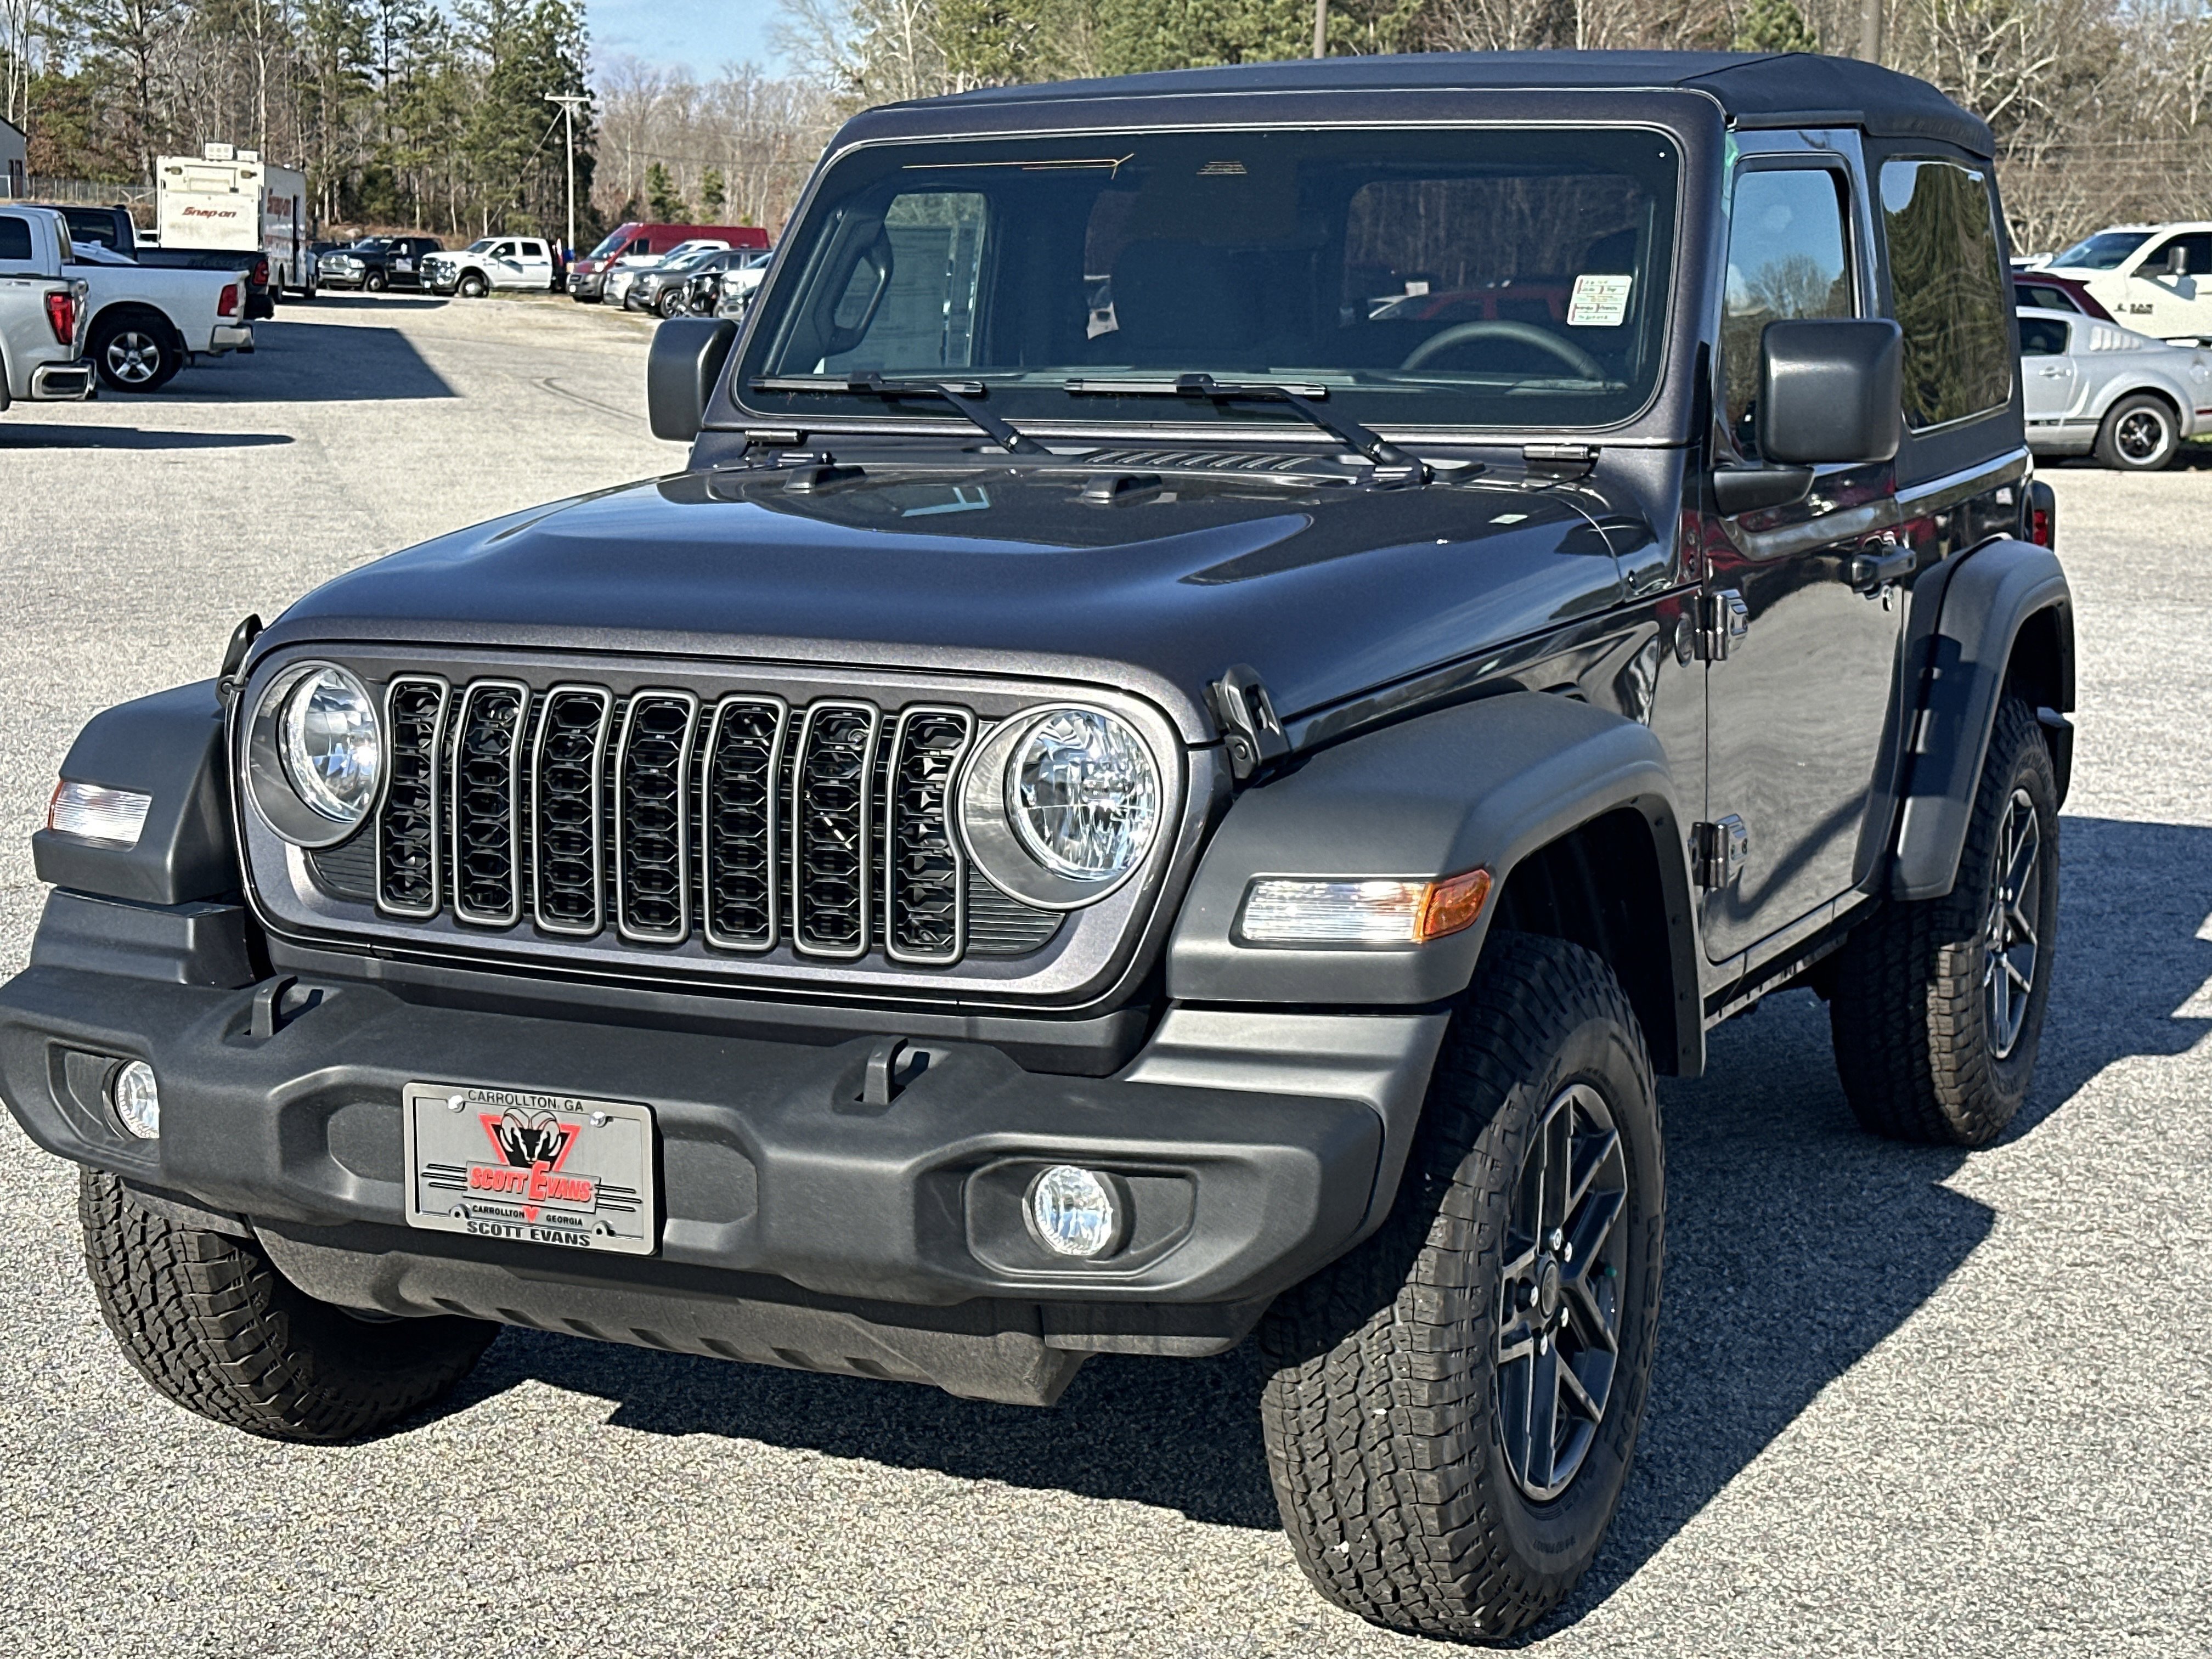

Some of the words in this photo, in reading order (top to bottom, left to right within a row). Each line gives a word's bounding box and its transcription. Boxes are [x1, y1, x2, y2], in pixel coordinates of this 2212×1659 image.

[182, 206, 237, 218] Snap-on
[468, 1090, 560, 1110] CARROLLTON,
[564, 1099, 584, 1112] GA
[470, 1167, 529, 1195] SCOTT
[528, 1160, 593, 1202] EVANS
[472, 1205, 525, 1219] CARROLLTON
[546, 1215, 584, 1227] GEORGIA
[466, 1221, 524, 1238] SCOTT
[530, 1228, 591, 1247] EVANS
